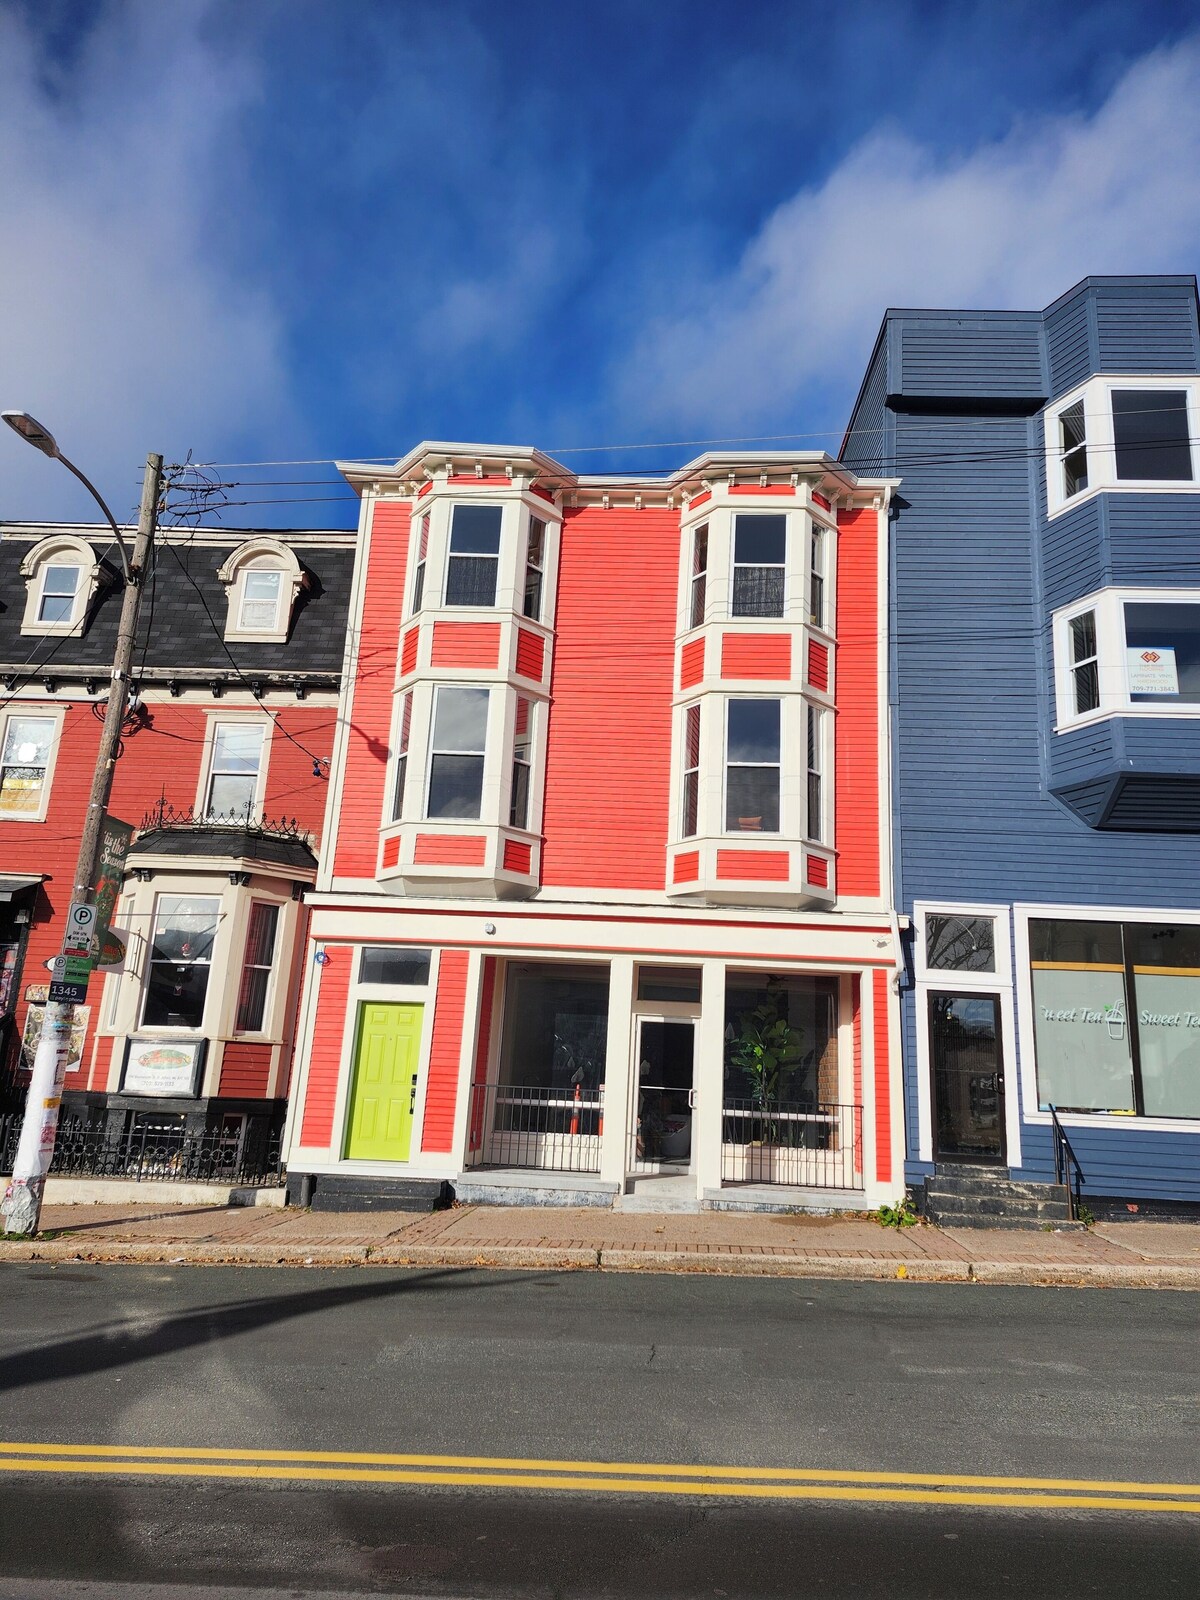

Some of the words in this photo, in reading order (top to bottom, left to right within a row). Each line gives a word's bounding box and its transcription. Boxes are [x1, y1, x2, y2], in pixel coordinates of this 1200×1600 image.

[111, 838, 125, 856] the
[52, 986, 77, 996] 1345
[1080, 1007, 1103, 1024] Tea
[1140, 1009, 1180, 1027] Sweet
